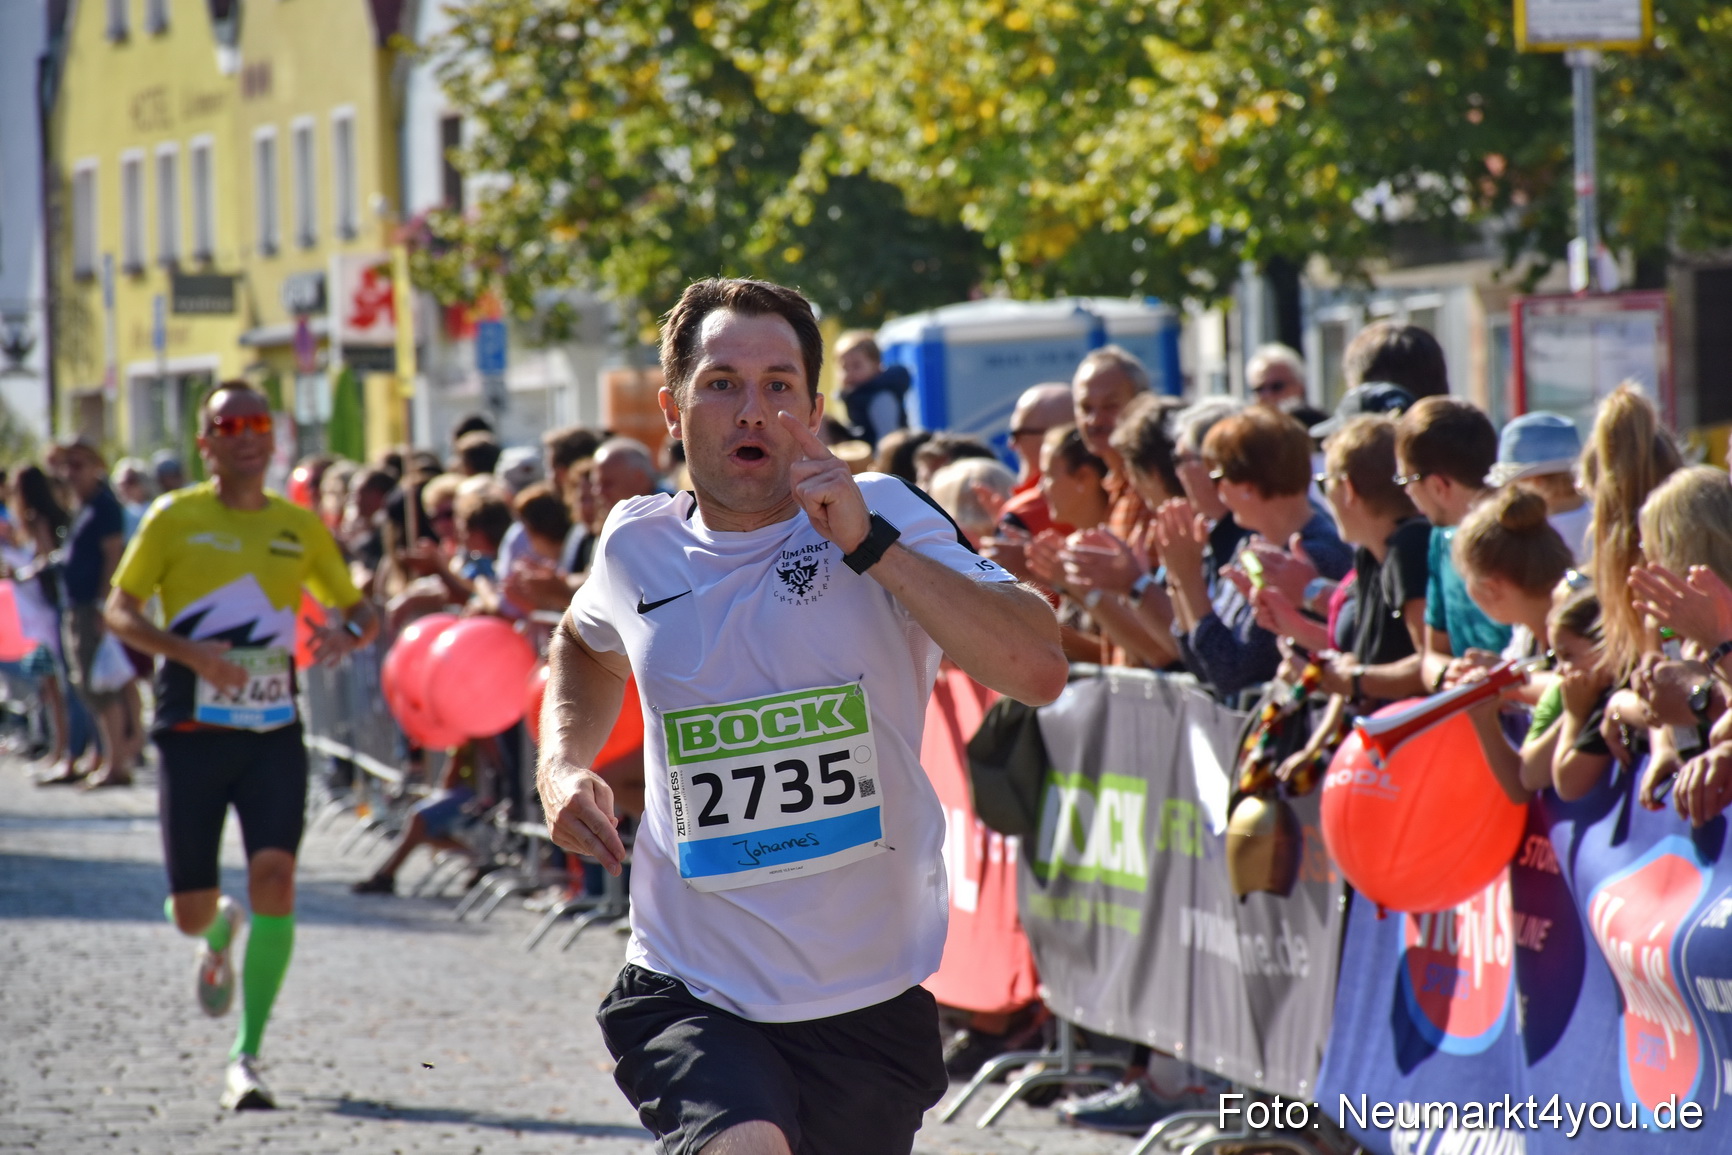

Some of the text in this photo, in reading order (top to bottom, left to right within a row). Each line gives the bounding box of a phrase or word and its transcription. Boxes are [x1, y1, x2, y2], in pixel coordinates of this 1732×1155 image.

[779, 540, 831, 561] UMARKT
[788, 568, 810, 585] ASV
[677, 693, 854, 757] BOCK
[691, 749, 856, 828] 2735
[732, 832, 820, 866] Johannes
